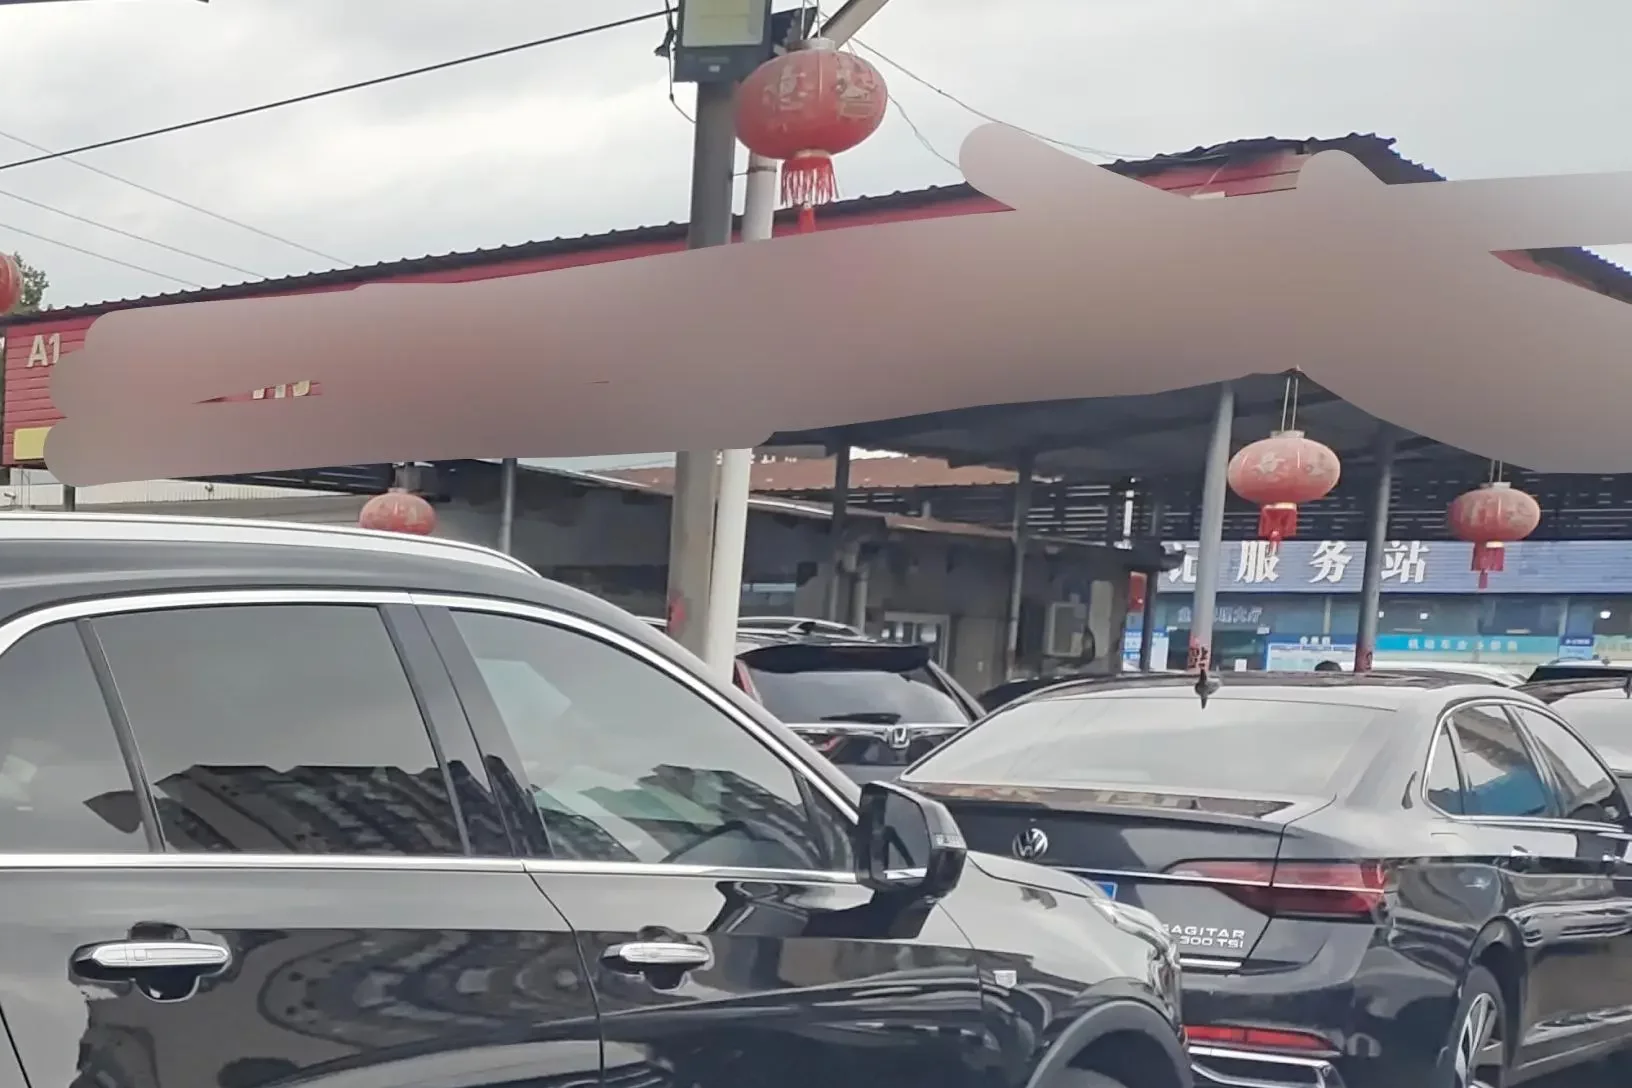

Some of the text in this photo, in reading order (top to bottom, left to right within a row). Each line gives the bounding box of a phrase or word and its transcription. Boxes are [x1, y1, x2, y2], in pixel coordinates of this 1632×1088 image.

[26, 333, 61, 368] A1
[1179, 935, 1244, 948] 300 TSI
